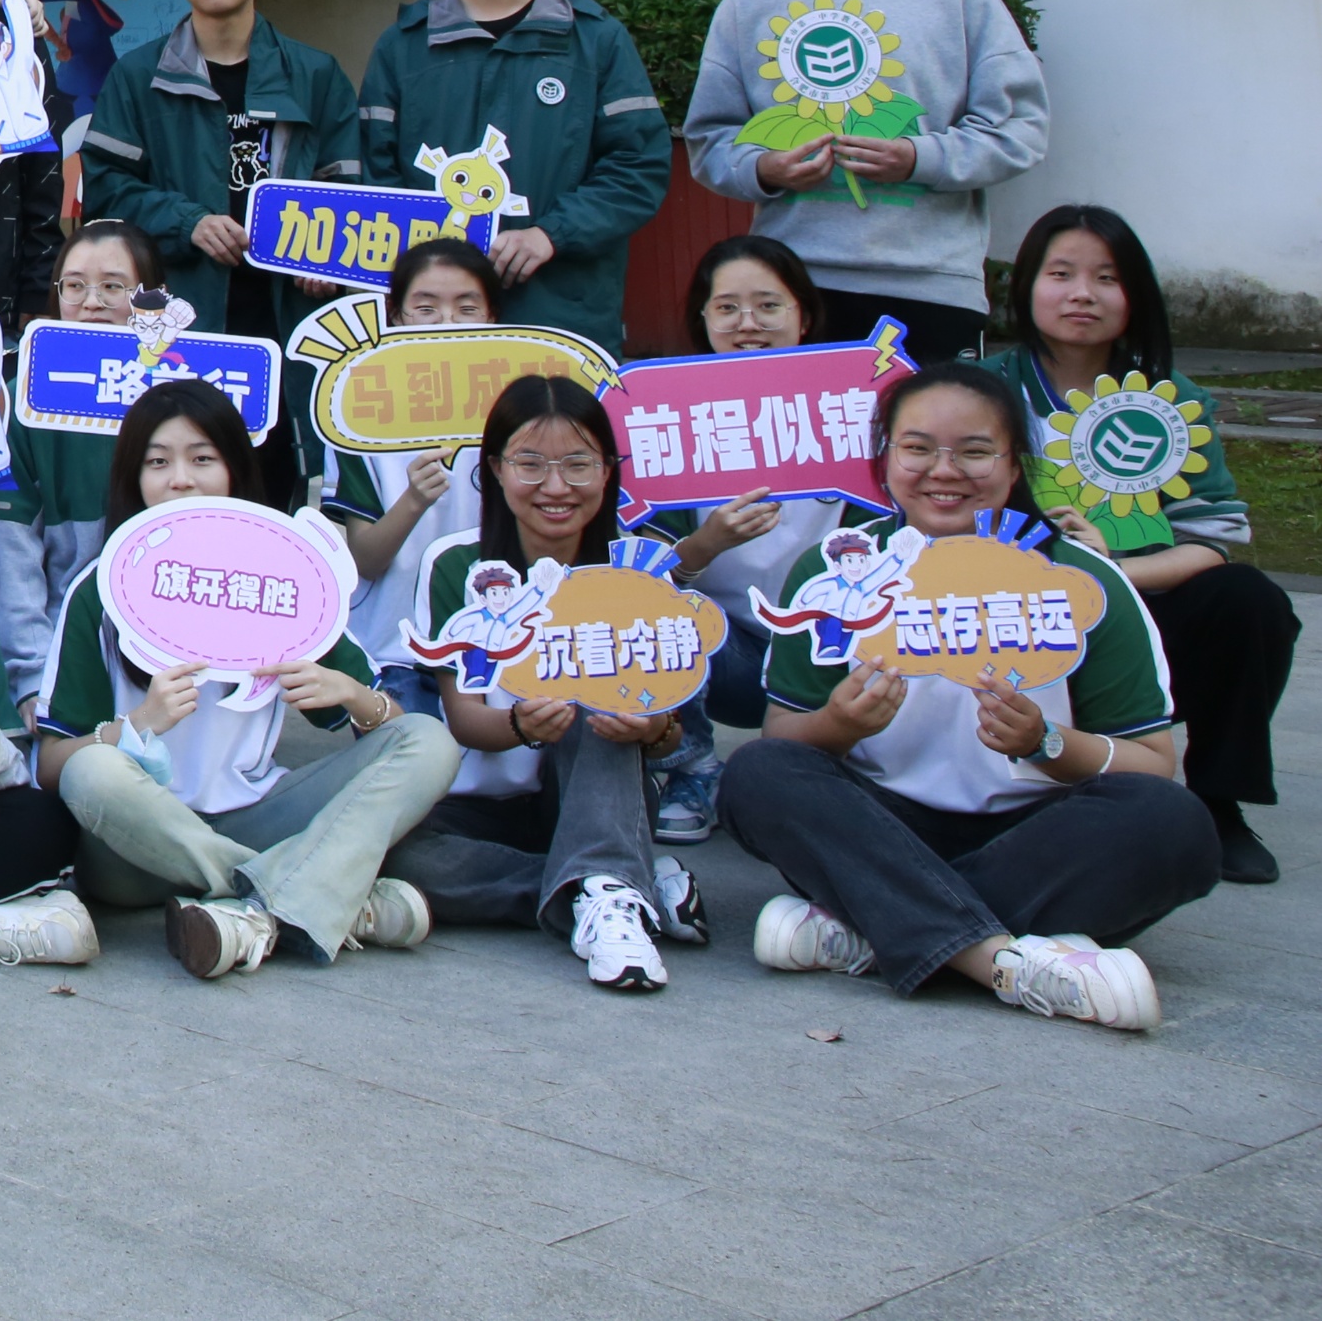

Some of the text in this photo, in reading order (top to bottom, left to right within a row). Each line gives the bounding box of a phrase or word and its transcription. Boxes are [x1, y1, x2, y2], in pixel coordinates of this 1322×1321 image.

[350, 355, 570, 424] 马到成
[624, 387, 877, 478] 前程似锦
[153, 559, 300, 618] 旗开得胜
[893, 588, 1081, 656] 志存高远
[534, 615, 700, 680] 沉着冷静
